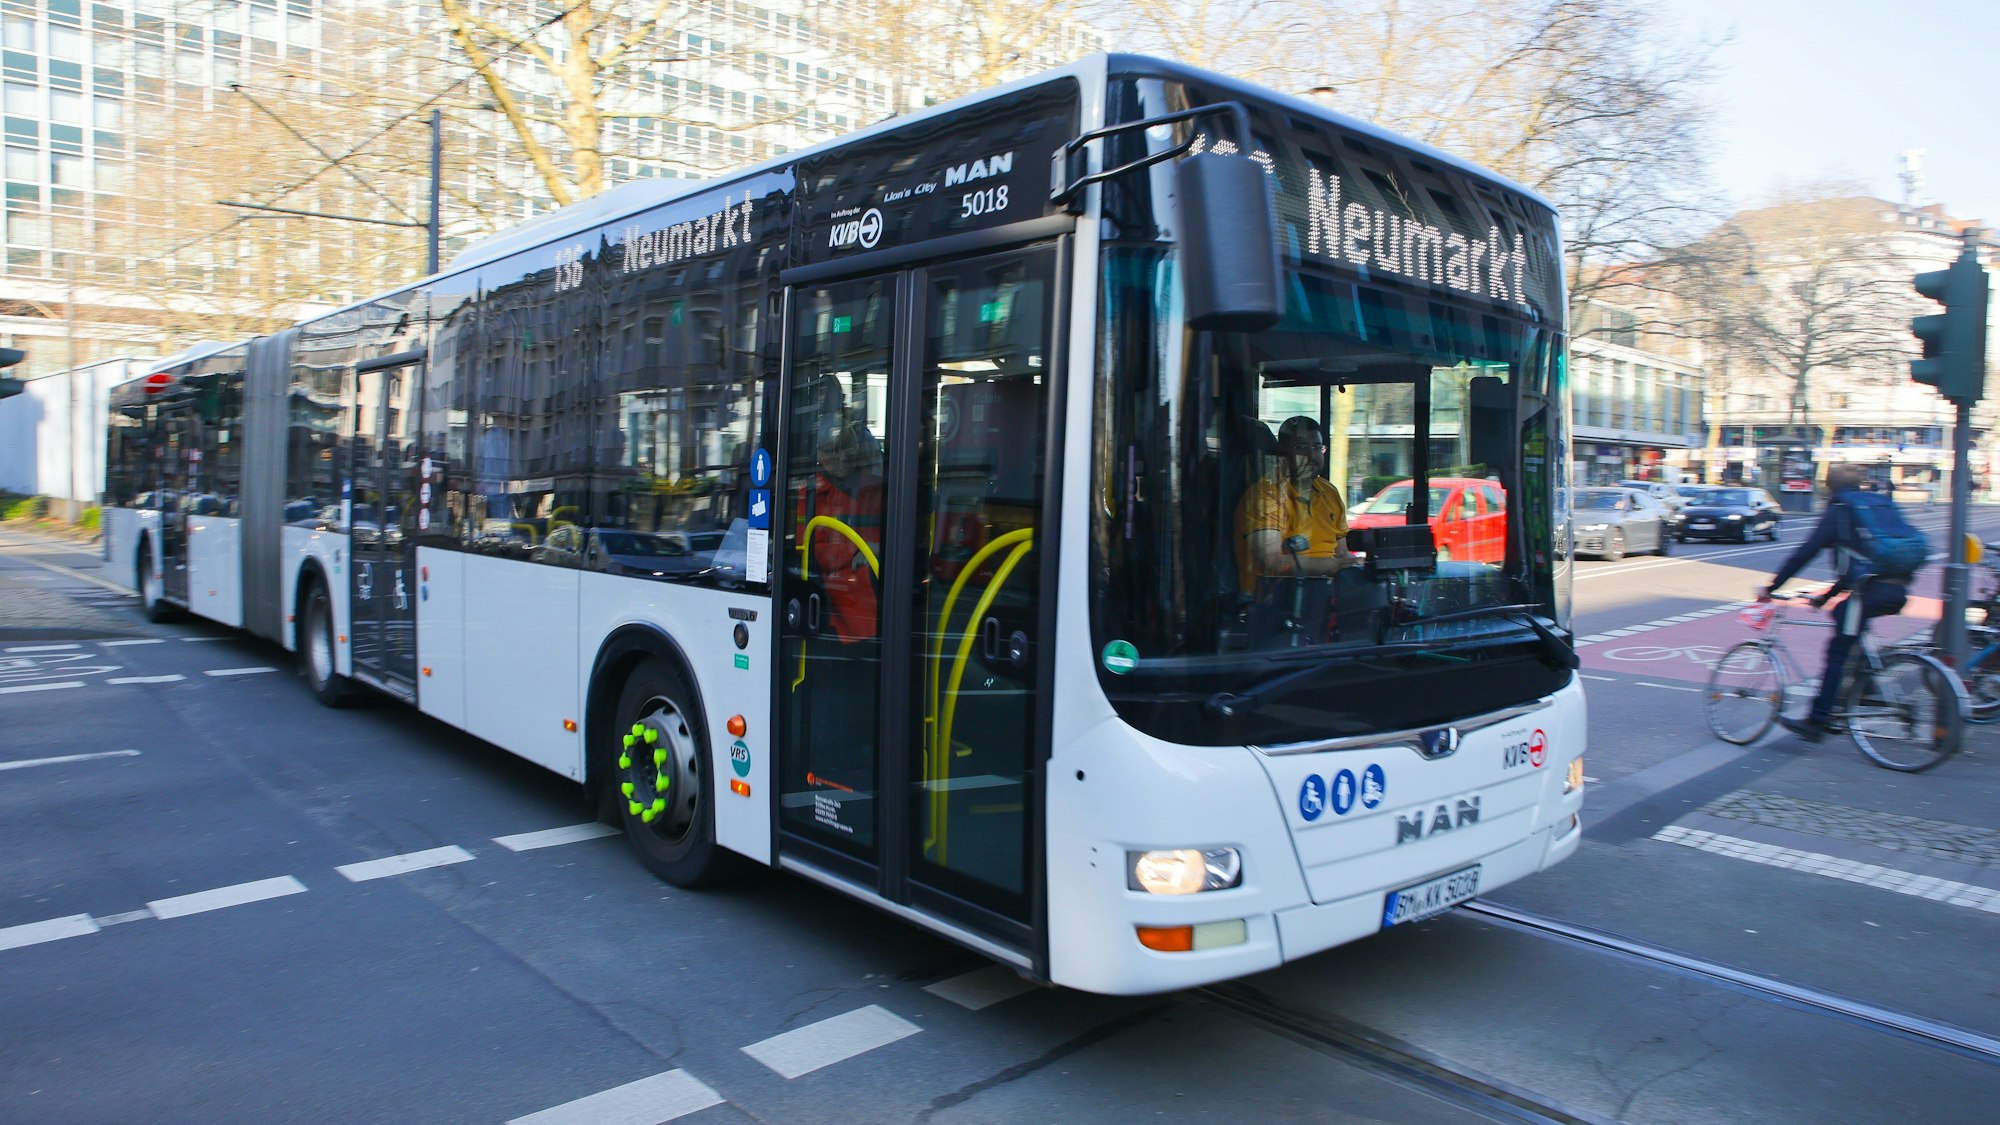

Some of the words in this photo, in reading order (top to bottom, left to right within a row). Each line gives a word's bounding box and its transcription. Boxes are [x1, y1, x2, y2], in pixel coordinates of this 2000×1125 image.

[944, 151, 1014, 188] MAN
[883, 187, 911, 203] Lion's
[914, 182, 938, 197] City
[960, 184, 1009, 219] 5018
[837, 209, 853, 218] Auftrag
[853, 206, 861, 214] der
[554, 244, 584, 293] 136
[622, 190, 754, 274] Neumarkt
[828, 220, 860, 248] KVB
[1308, 168, 1527, 305] Neumarkt
[730, 745, 746, 760] VRS
[1502, 742, 1530, 770] KVB
[1396, 795, 1481, 844] MAN
